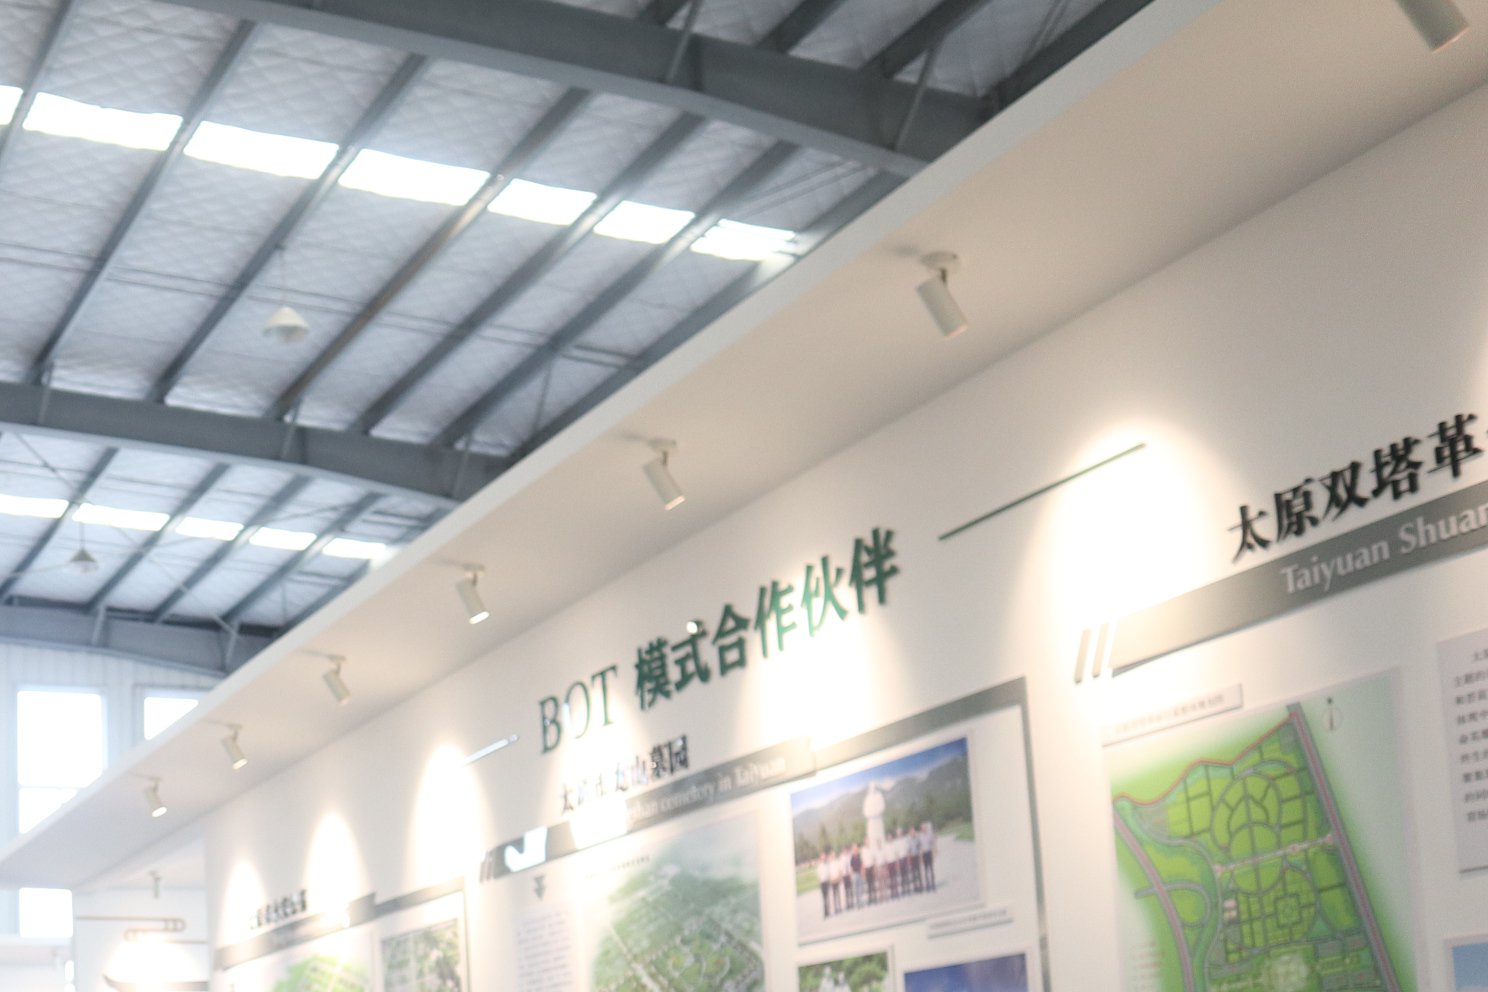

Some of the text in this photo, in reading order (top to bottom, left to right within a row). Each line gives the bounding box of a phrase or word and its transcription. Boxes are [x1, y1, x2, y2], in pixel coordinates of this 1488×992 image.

[1281, 540, 1391, 595] Taiyuan
[538, 527, 900, 755] BOT 模式合作伙伴
